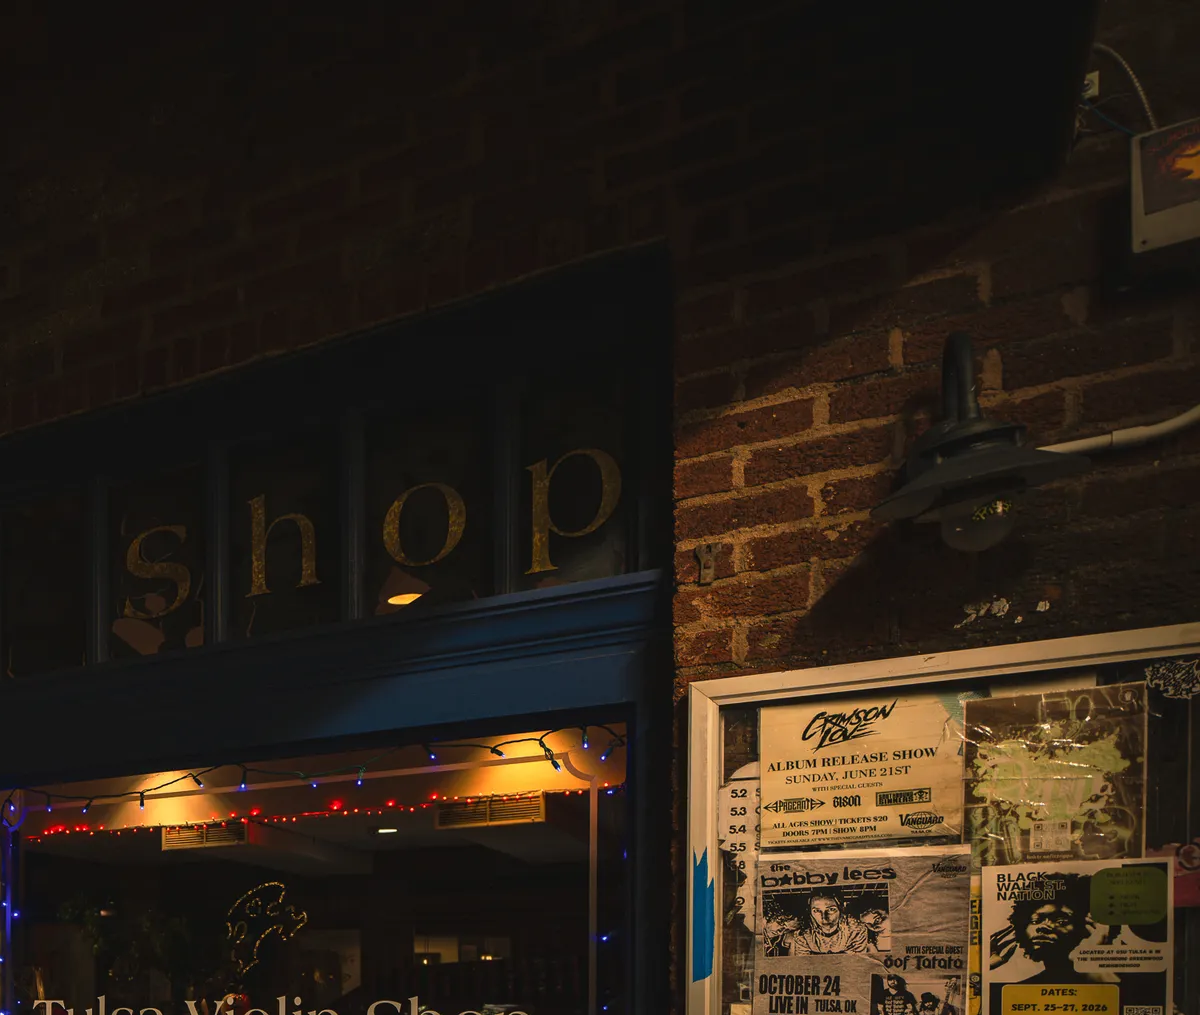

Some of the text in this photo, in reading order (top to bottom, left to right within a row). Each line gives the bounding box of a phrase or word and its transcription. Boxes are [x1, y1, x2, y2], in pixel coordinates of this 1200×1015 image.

[122, 448, 622, 619] shop
[801, 699, 898, 741] CRIMSON
[811, 722, 880, 753] LOVE
[767, 747, 938, 773] ALBUM RELEASE SHOW
[785, 765, 911, 785] SUNDAY, JUNE 21ST
[731, 789, 747, 798] 5.2
[730, 807, 747, 816] 5.3
[810, 819, 833, 827] SHOW
[899, 814, 944, 826] VANGUARD
[729, 825, 746, 834] 5.4
[730, 843, 746, 852] 5.5
[770, 863, 790, 872] the
[843, 866, 896, 880] lees
[997, 872, 1048, 883] BLACK
[997, 880, 1066, 891] WALL ST.
[997, 889, 1056, 902] NATION
[906, 946, 964, 954] WITH SPECIAL GUEST
[759, 974, 840, 996] OCTOBER 24
[1041, 988, 1077, 996] DATES:
[769, 996, 857, 1014] LIVE IN TULSA, OK
[1011, 1003, 1040, 1011] SEPT.
[1082, 1004, 1108, 1012] 2026
